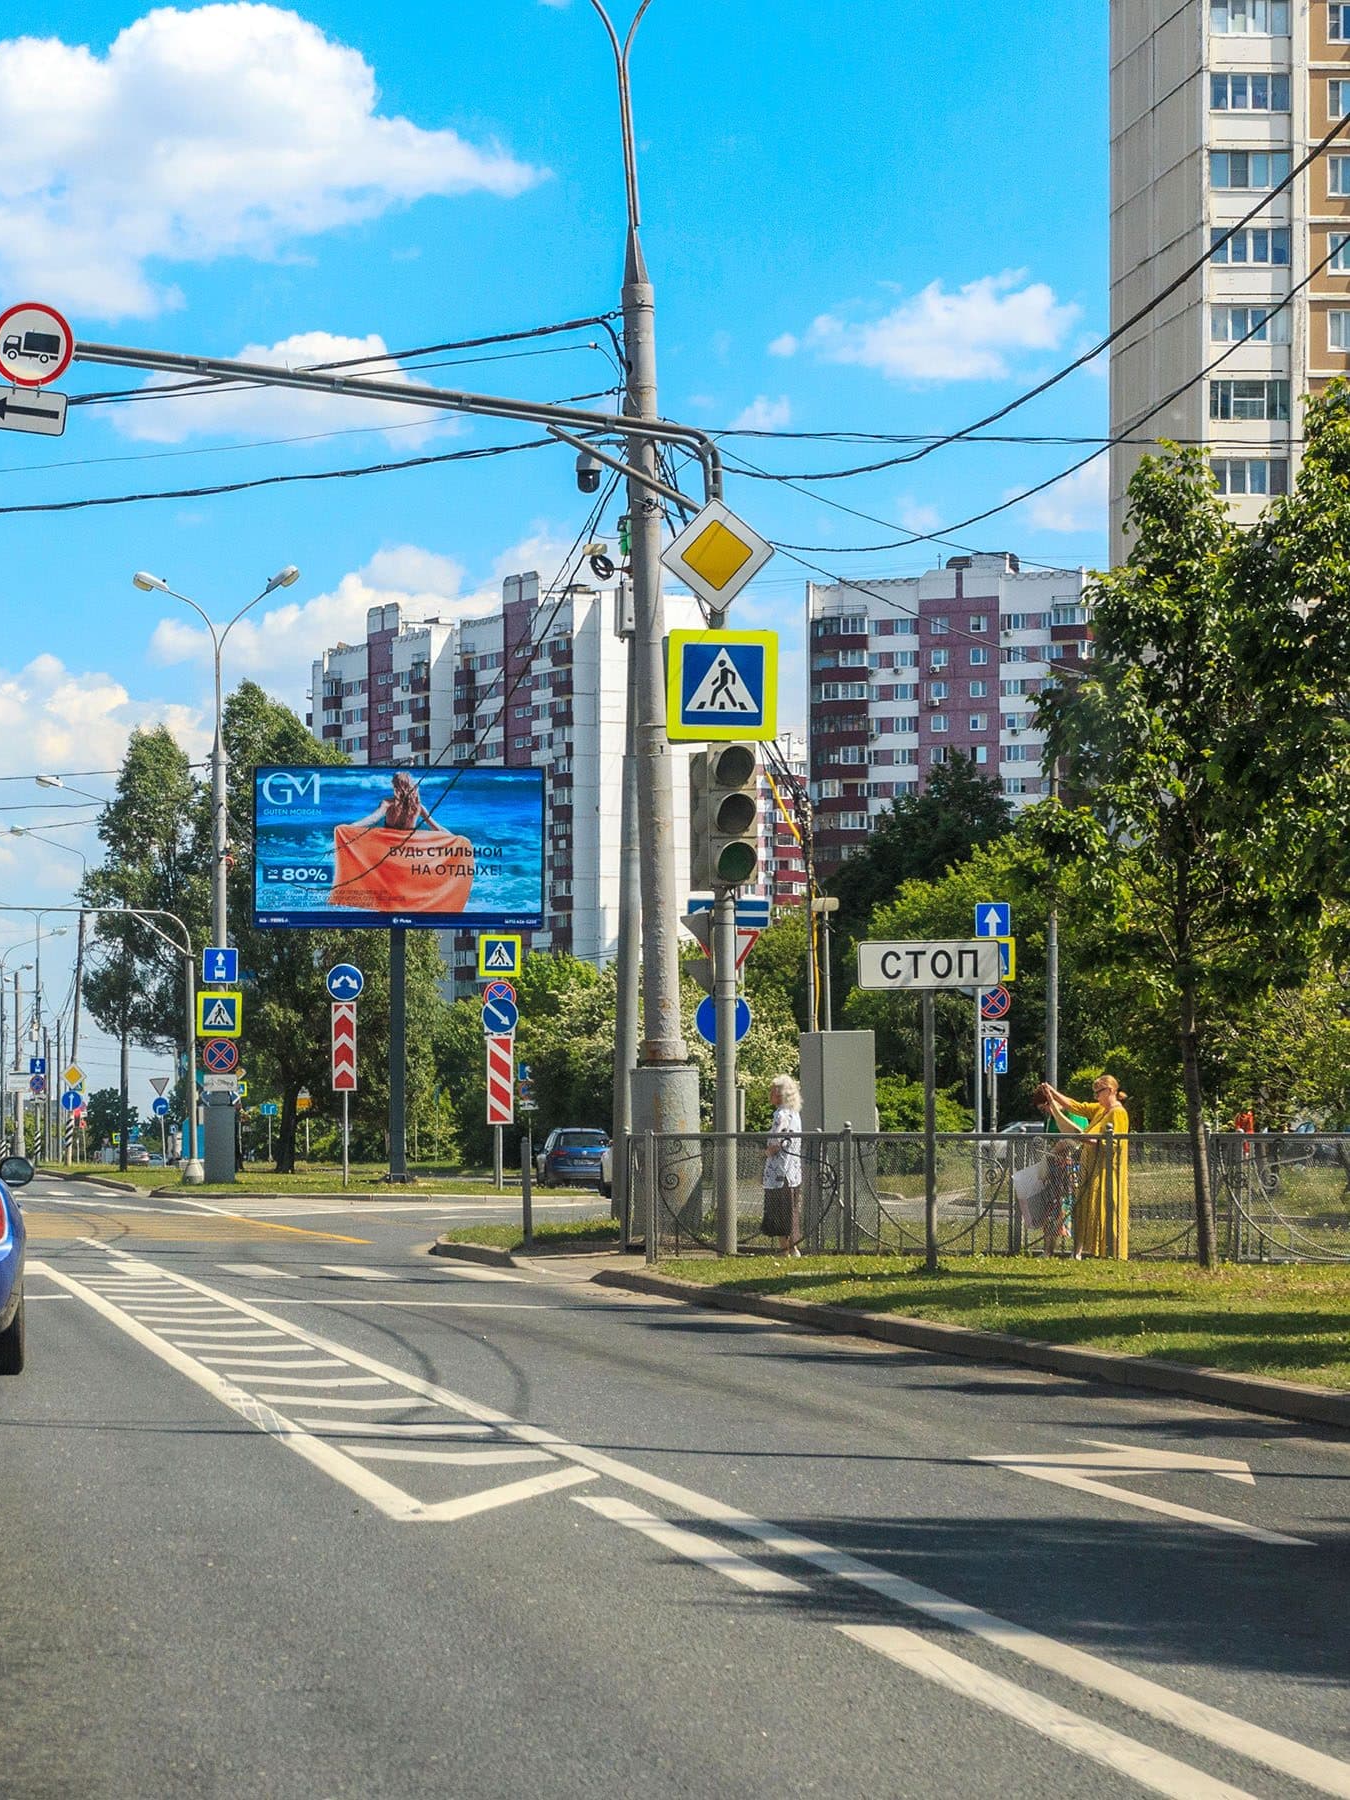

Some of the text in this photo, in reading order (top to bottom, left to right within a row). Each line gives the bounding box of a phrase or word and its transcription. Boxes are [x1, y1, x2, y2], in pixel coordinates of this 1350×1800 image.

[263, 808, 322, 816] GUTEN MORGEN
[390, 845, 503, 858] БУДЬ СТИЛЬНОЙ
[411, 864, 503, 878] НА ОТДЫХЕ!
[880, 949, 979, 980] СТОП
